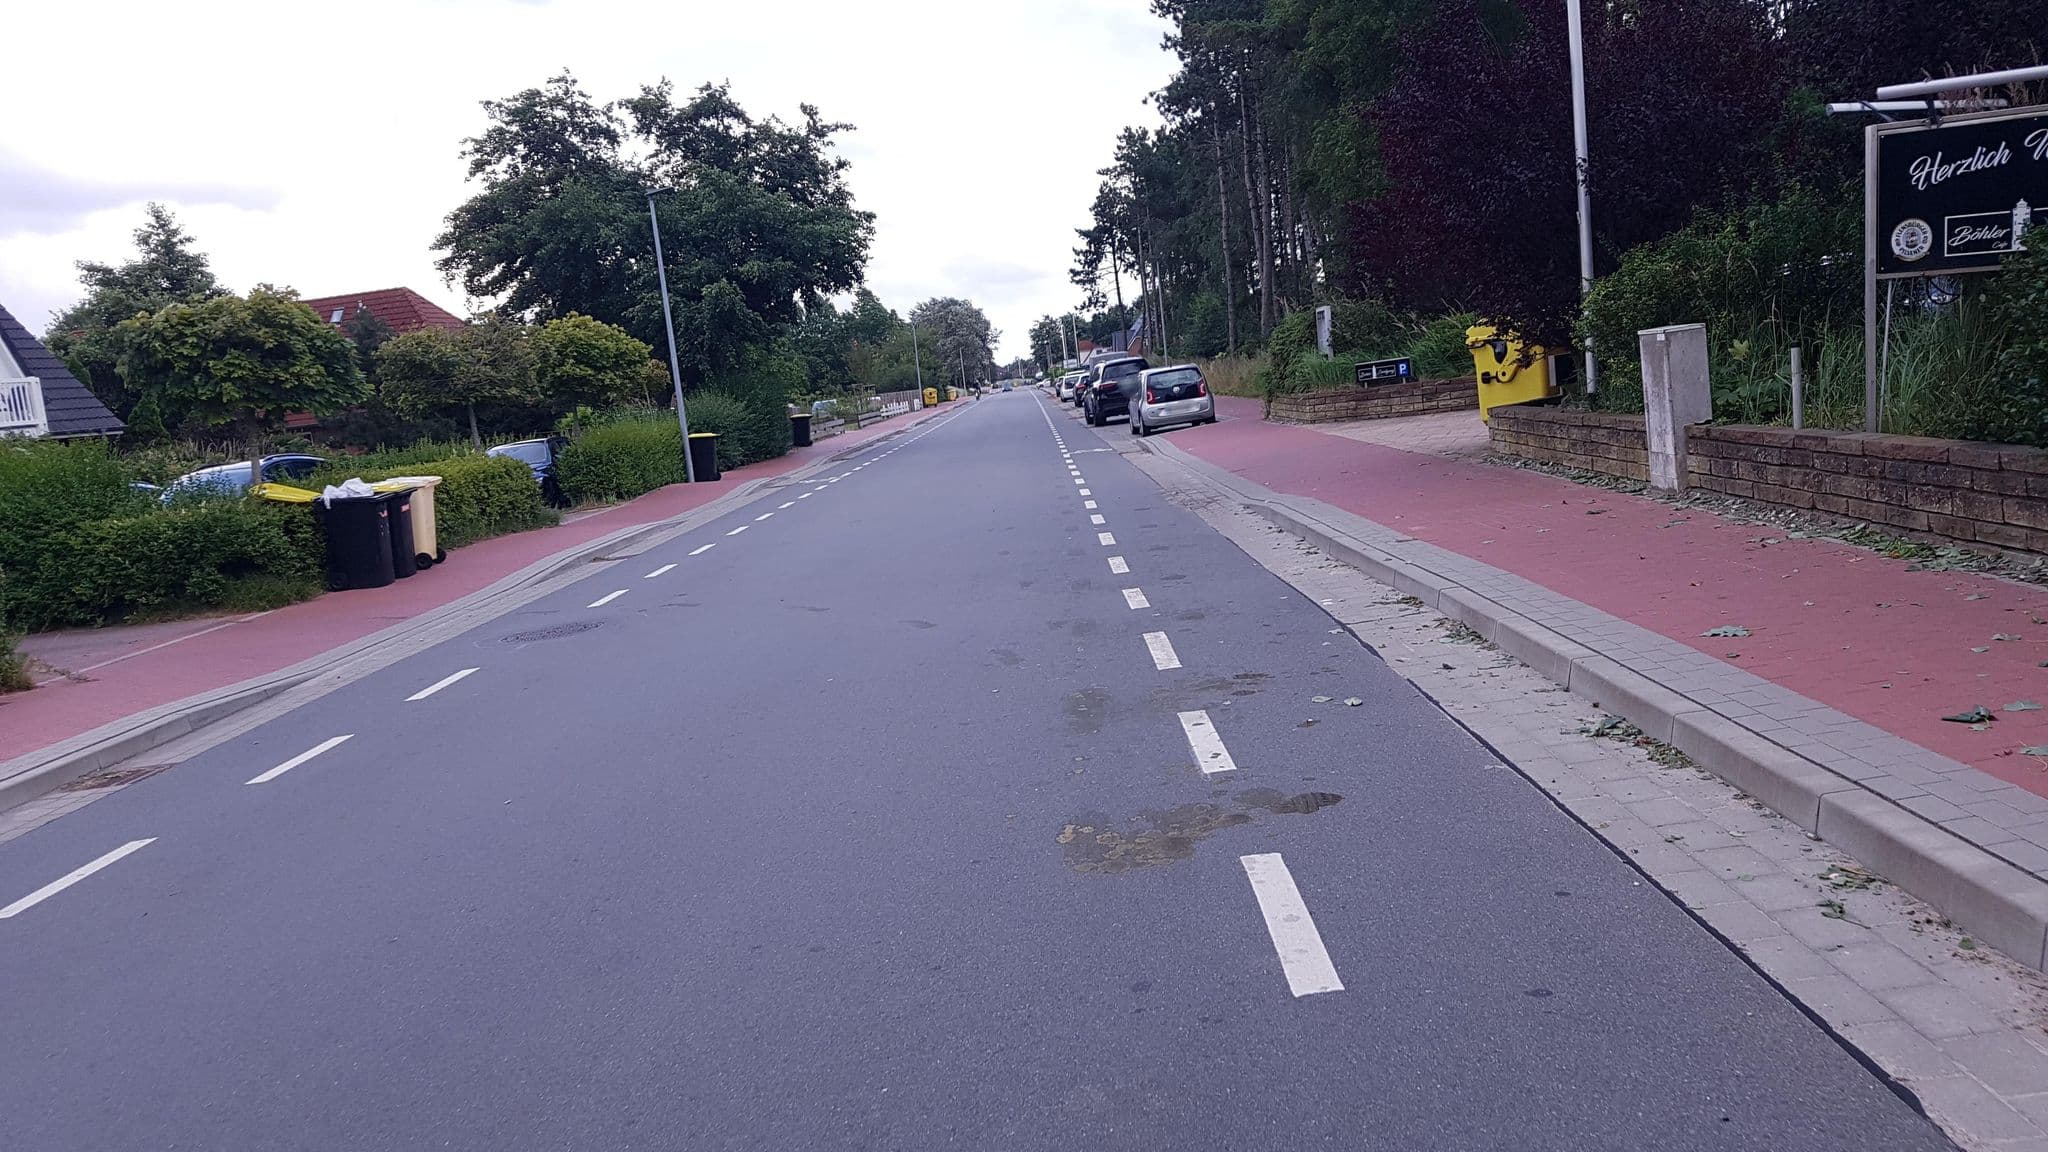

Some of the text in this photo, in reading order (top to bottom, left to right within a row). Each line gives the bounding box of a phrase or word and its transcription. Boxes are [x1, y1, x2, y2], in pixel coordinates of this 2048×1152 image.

[1909, 141, 2012, 190] Herzlich
[1948, 225, 2011, 247] Böhler
[1399, 363, 1407, 375] P
